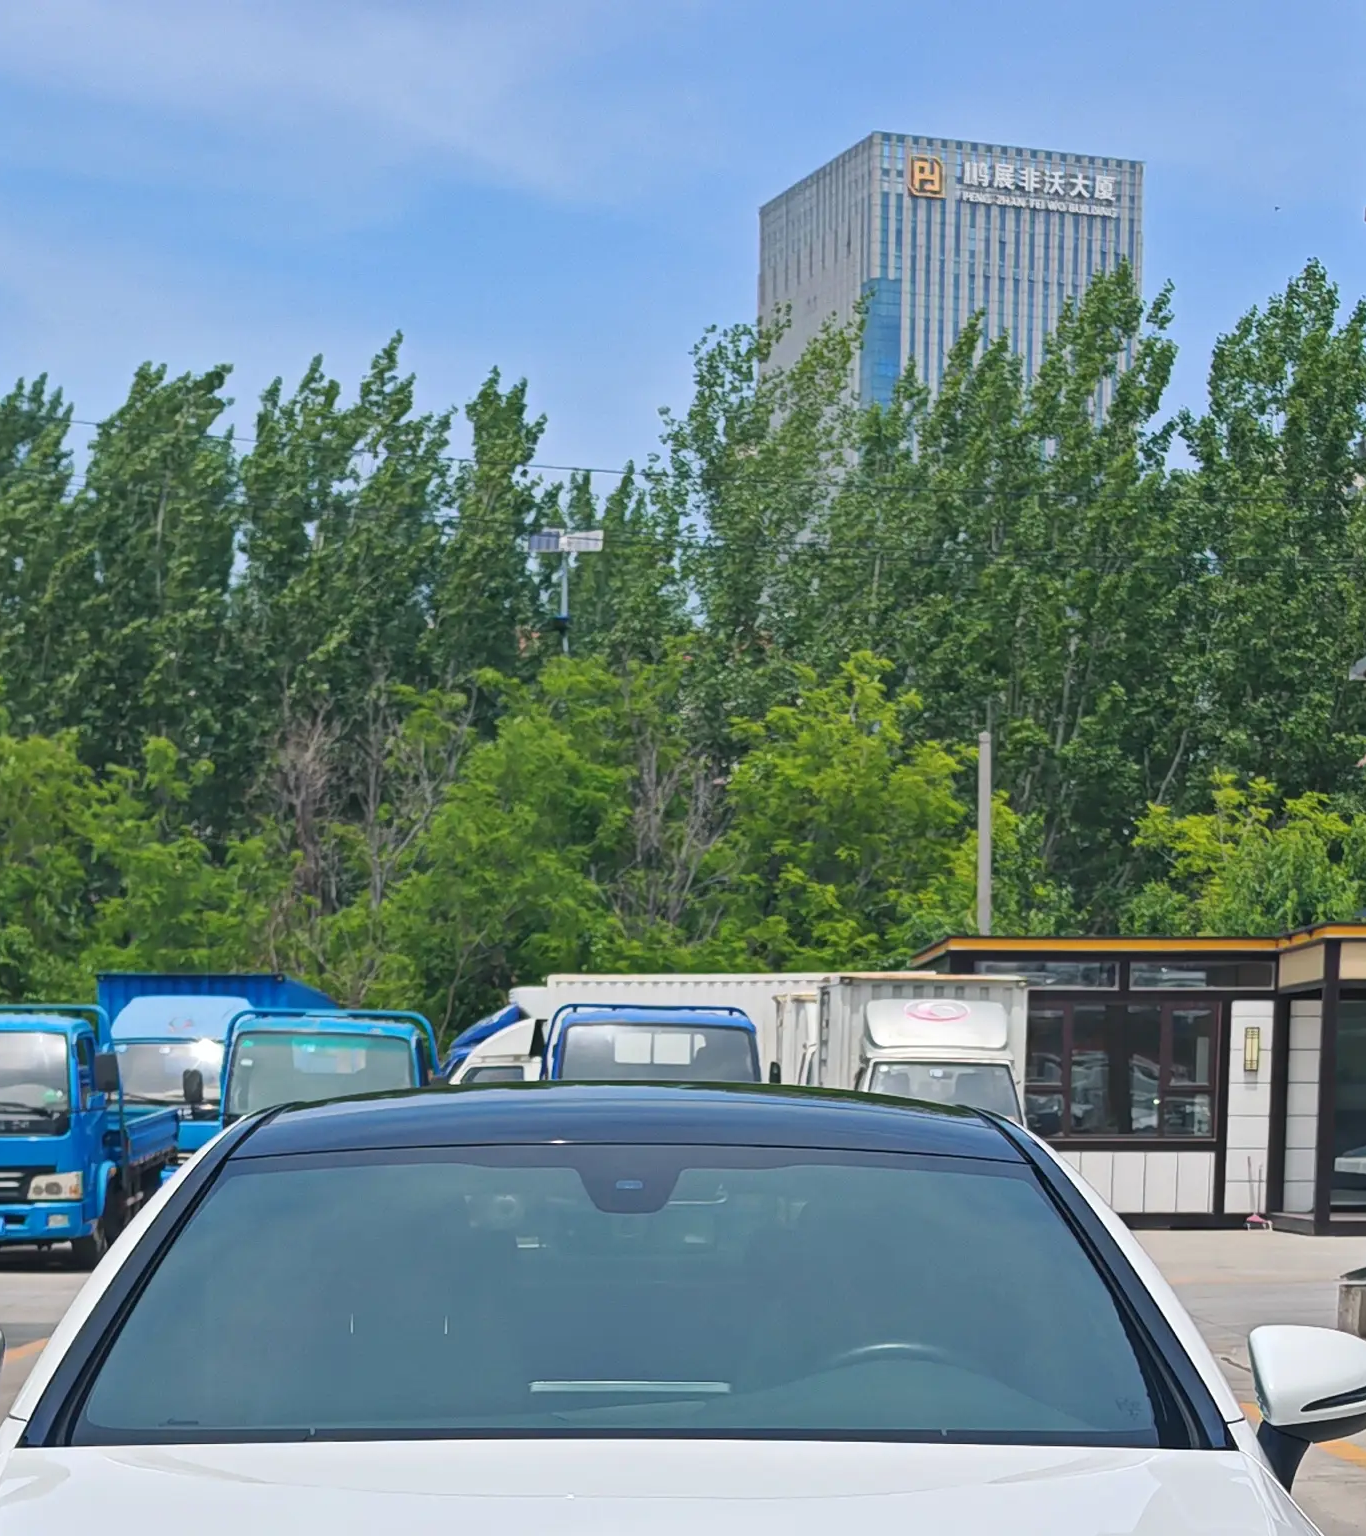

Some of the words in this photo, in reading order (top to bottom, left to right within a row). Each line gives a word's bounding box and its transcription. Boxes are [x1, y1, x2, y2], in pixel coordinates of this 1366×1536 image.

[962, 160, 1117, 201] 鹏展非沃大厦
